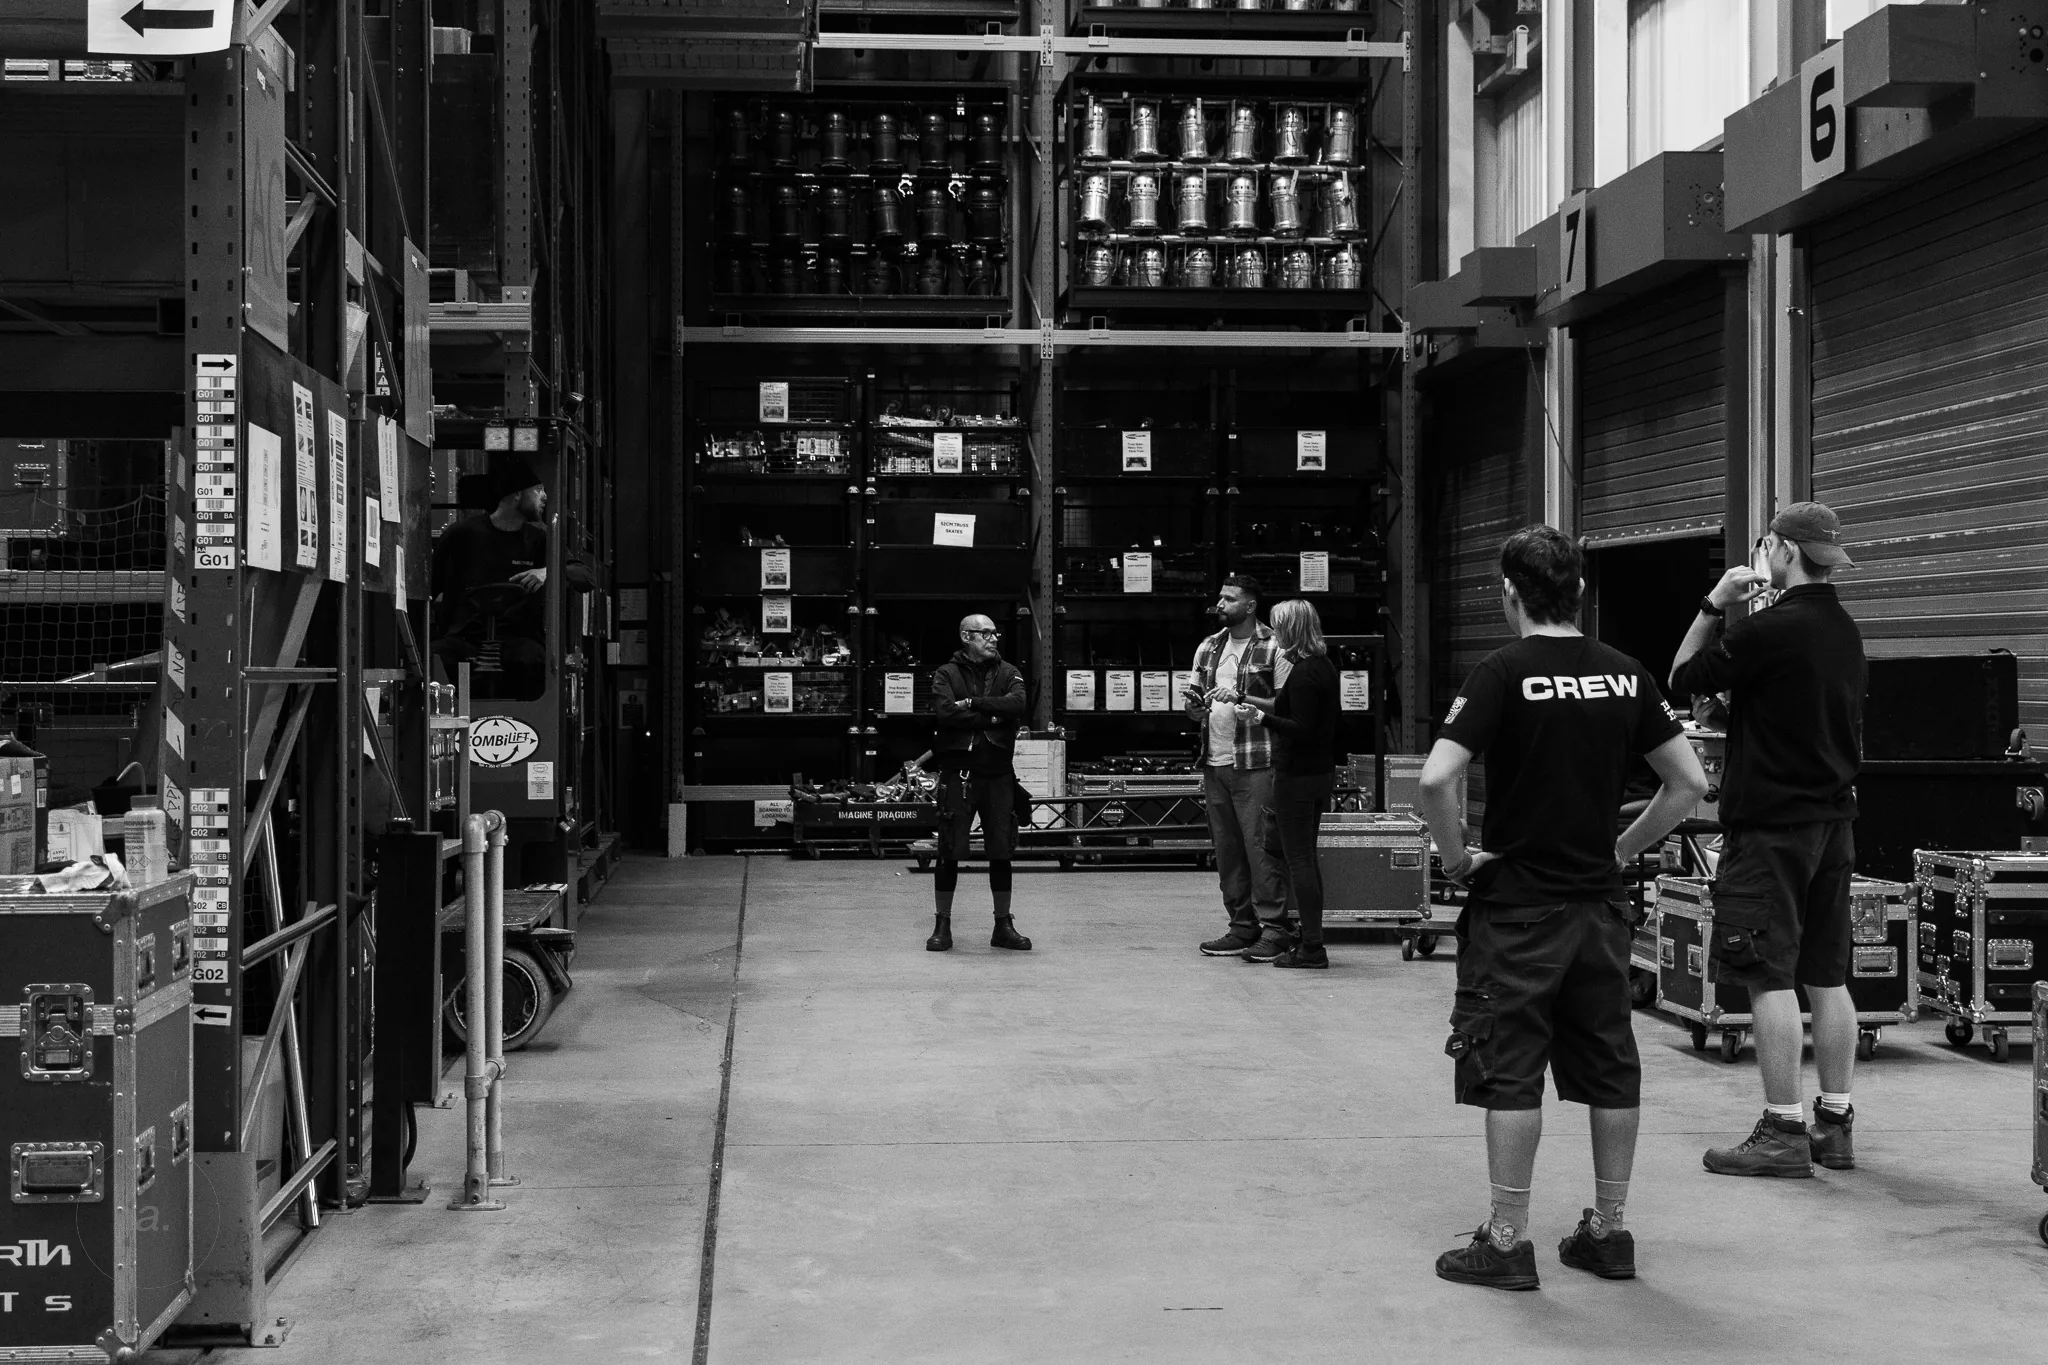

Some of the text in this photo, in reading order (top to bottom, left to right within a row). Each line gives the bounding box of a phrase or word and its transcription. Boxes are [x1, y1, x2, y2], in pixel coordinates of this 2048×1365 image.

[1809, 65, 1837, 164] 6
[1565, 207, 1581, 284] 7
[197, 390, 214, 398] G01
[197, 414, 214, 422] G01
[197, 439, 214, 447] G01
[197, 463, 214, 471] G01
[197, 488, 213, 496] G01
[196, 512, 213, 520] G01
[200, 554, 229, 566] G01
[1522, 675, 1638, 701] CREW
[191, 804, 208, 812] G02
[838, 810, 918, 820] IMAGINE DRAGONS
[190, 828, 208, 836] G02
[191, 853, 208, 861] G02
[197, 877, 208, 885] 02
[193, 968, 224, 980] G02
